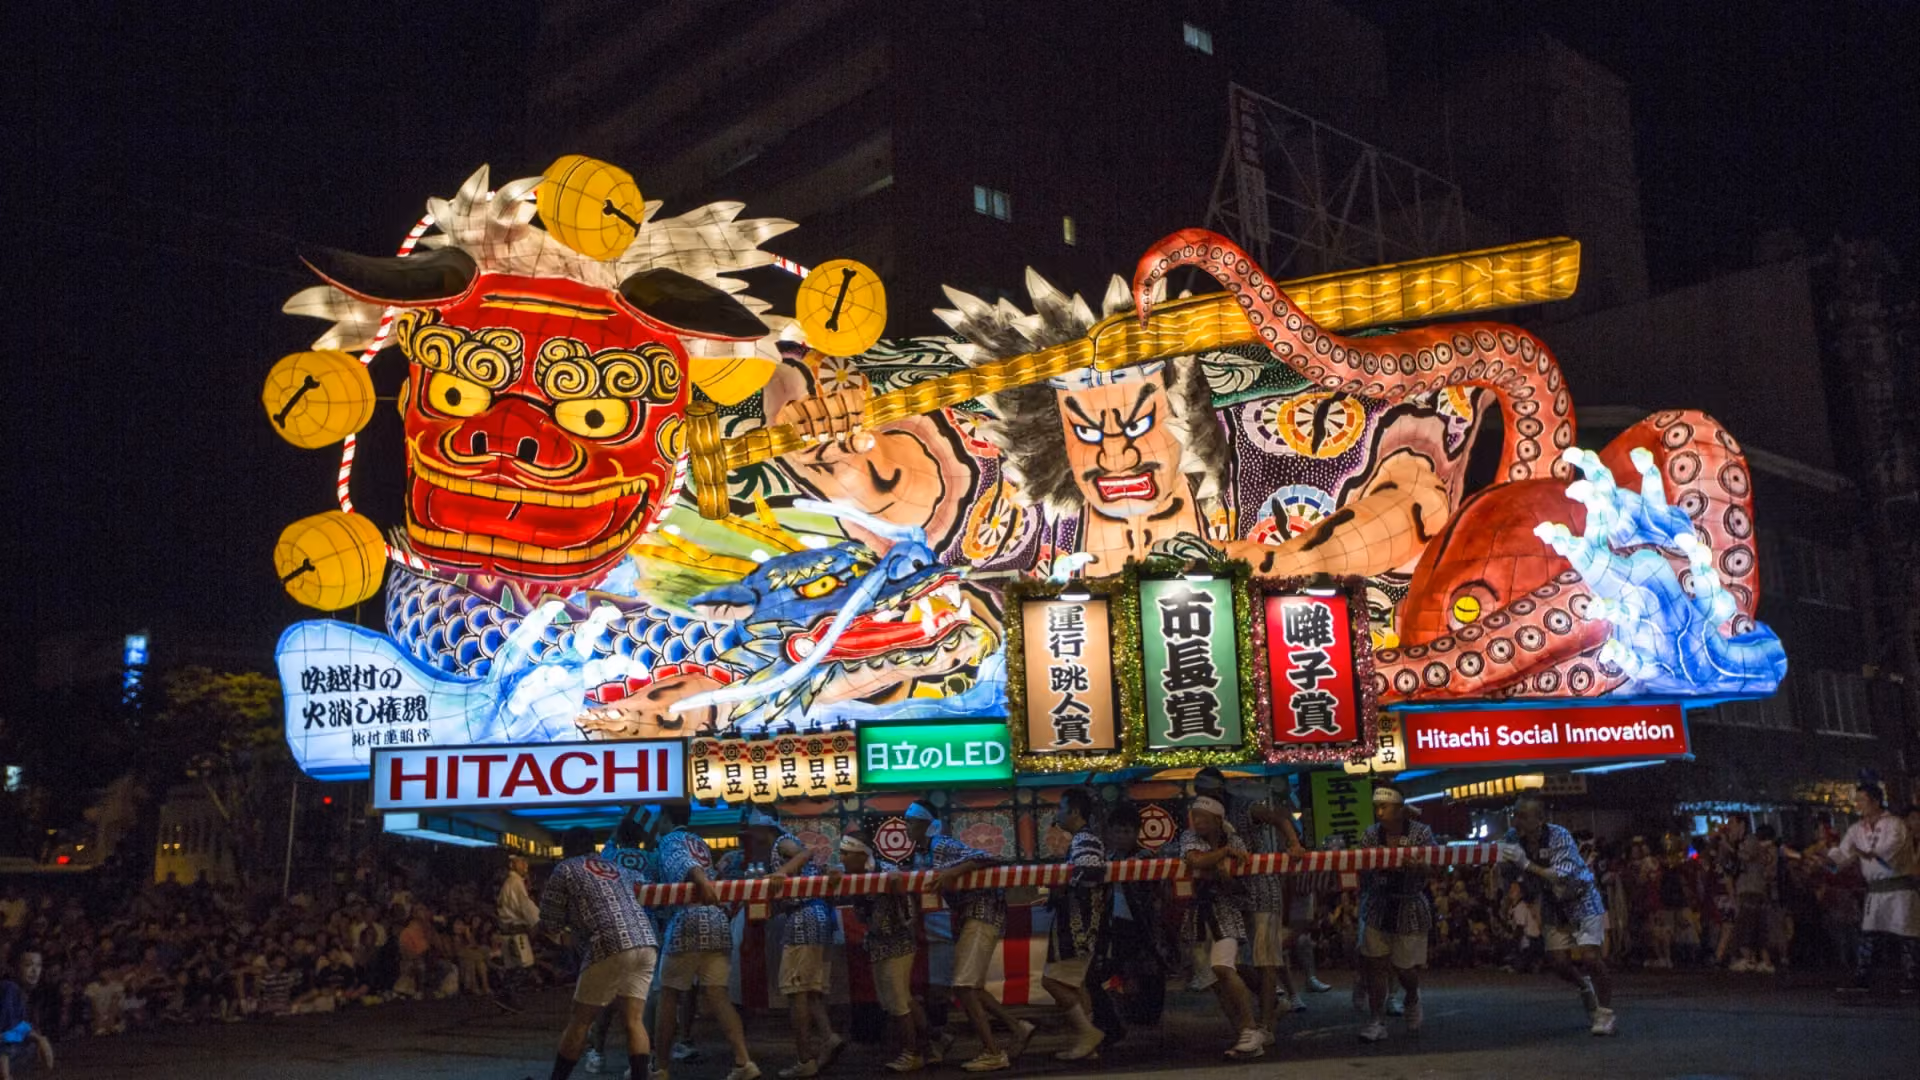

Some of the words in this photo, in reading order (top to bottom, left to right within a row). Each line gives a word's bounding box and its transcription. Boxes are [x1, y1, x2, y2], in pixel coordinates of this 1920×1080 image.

[1158, 588, 1224, 741] 市長賞
[1281, 603, 1341, 737] 囃子賞
[1379, 735, 1397, 764] 日立
[1416, 726, 1490, 749] Hitachi
[1496, 723, 1559, 746] Social
[1565, 720, 1675, 743] Innovation
[833, 755, 852, 786] 日立
[867, 740, 1005, 771] 日立のLED
[390, 748, 668, 800] HITACHI
[694, 759, 712, 791] 日立
[724, 763, 744, 795] 日立
[752, 765, 770, 796] 日立
[780, 757, 799, 789] 日立
[808, 758, 827, 789] 日立
